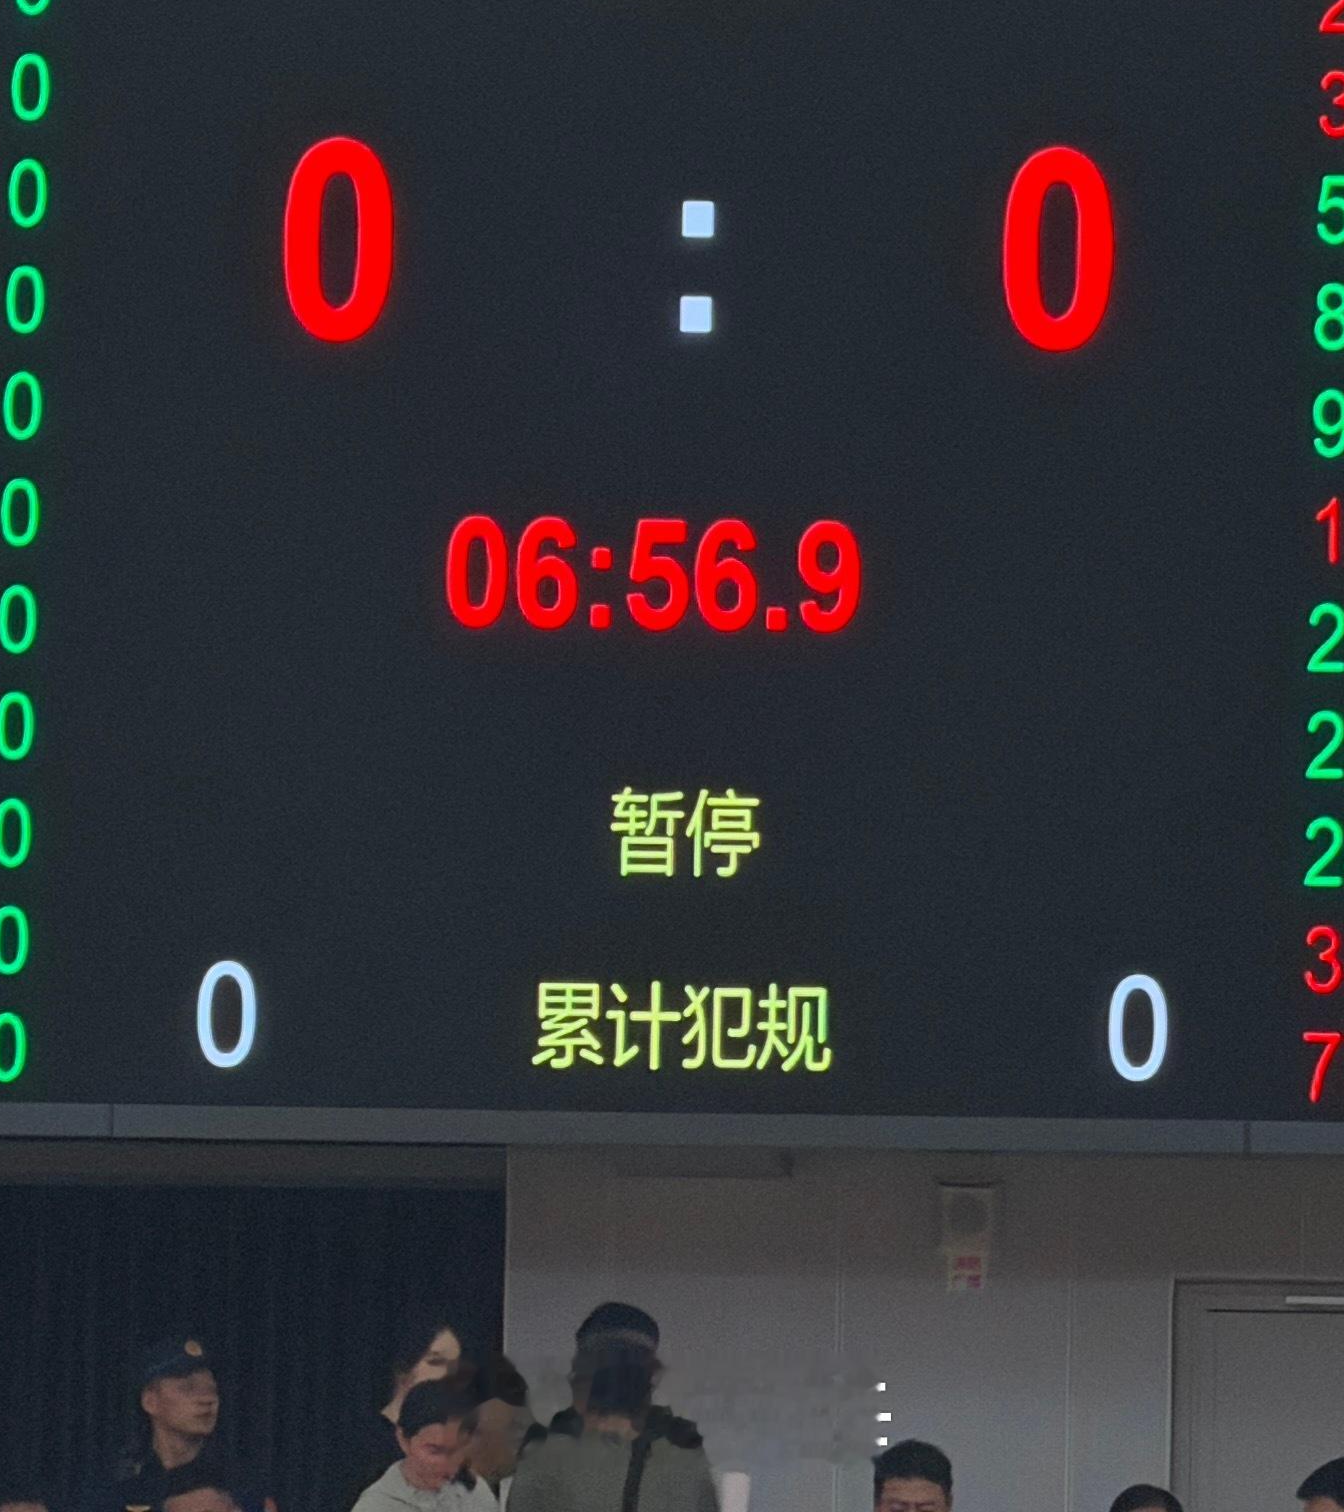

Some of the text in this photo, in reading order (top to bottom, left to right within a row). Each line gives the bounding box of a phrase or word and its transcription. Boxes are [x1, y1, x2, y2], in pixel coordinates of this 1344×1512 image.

[9, 51, 52, 123] 0
[6, 157, 49, 230] 0
[281, 134, 396, 345] 0
[1000, 143, 1117, 355] 0
[4, 264, 47, 336] 0
[1, 369, 44, 442] 0
[0, 476, 41, 549] 0
[444, 512, 863, 636] 06:56.9
[608, 785, 762, 879] 暂停
[195, 958, 1170, 1083] 0 累计犯规 0
